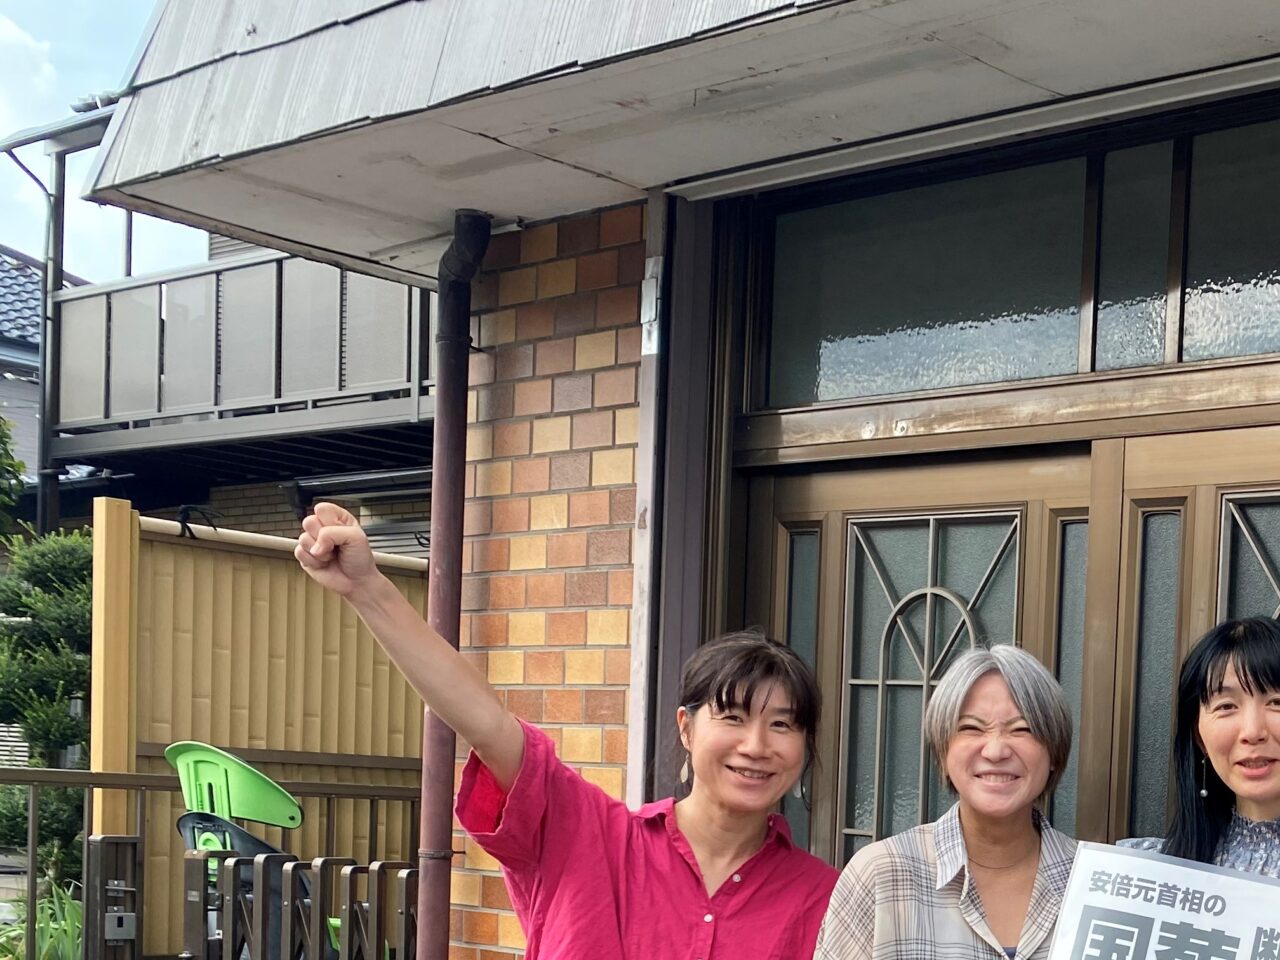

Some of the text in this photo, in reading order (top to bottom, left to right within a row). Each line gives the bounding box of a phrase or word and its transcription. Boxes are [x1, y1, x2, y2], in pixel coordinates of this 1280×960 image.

[1088, 870, 1227, 917] 安倍元首相の
